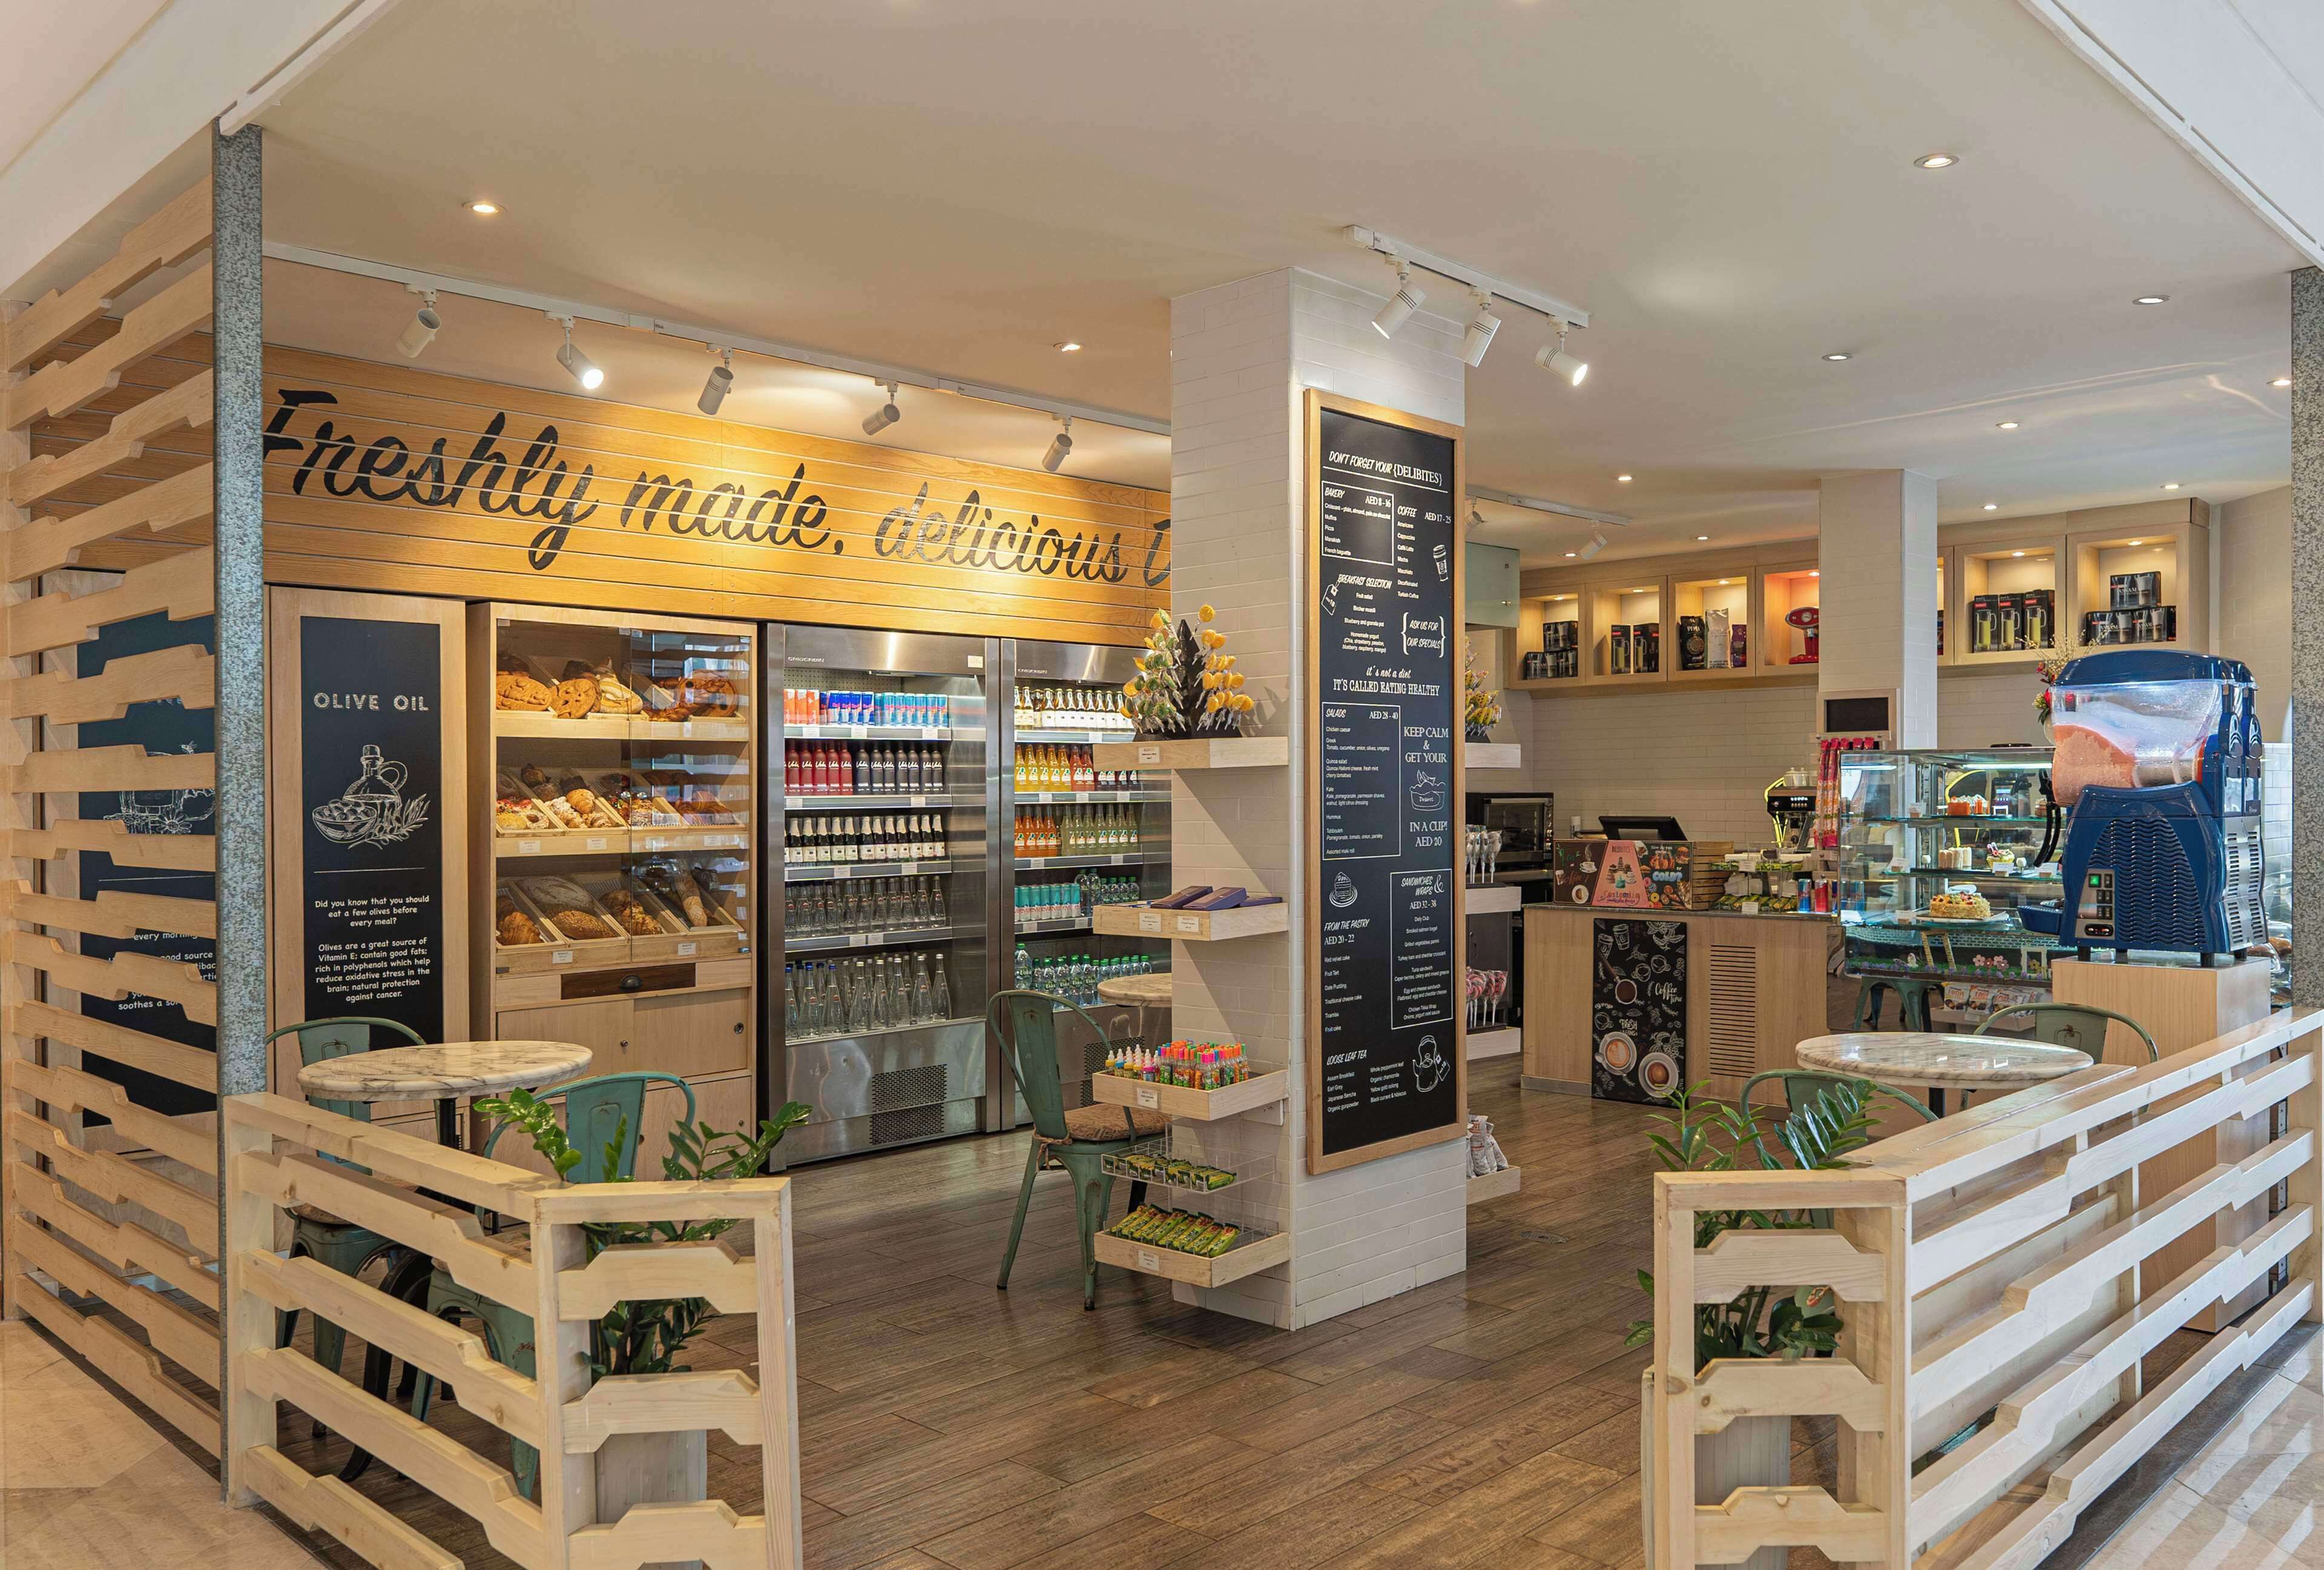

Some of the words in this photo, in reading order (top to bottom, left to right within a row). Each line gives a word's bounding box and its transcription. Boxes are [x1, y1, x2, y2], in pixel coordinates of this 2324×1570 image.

[1329, 451, 1350, 465] DON'T
[1349, 455, 1375, 470] FORGET
[1375, 460, 1392, 474] YOUR
[263, 389, 599, 571] Freshly
[621, 463, 844, 556] made,
[875, 482, 1128, 583] delicious
[1325, 487, 1345, 499] BAKERY
[1365, 496, 1378, 505] AED
[1386, 499, 1391, 508] 16
[1397, 505, 1417, 517] COFFEE
[1424, 512, 1436, 521] AED
[1338, 574, 1366, 586] BREAKFAST
[1366, 577, 1392, 590] SELECTION
[1409, 620, 1420, 629] ASK
[1420, 622, 1427, 630] US
[1427, 622, 1439, 631] FOR
[1407, 637, 1418, 646] OUR
[1418, 639, 1441, 649] SPECIALS
[1380, 668, 1392, 677] not
[1398, 669, 1411, 678] diet
[1333, 679, 1348, 691] IT'S
[1349, 680, 1378, 692] CALLED
[1380, 683, 1407, 694] EATING
[1408, 684, 1440, 696] HEALTHY
[314, 692, 379, 711] OLIVE
[393, 695, 429, 711] OIL
[1326, 709, 1346, 718] SALADS
[1404, 726, 1424, 737] KEEP
[1426, 728, 1449, 738] CALM
[1423, 740, 1430, 750] &
[1405, 752, 1421, 763] GET
[1423, 753, 1447, 763] YOUR
[1410, 822, 1420, 832] IN
[1421, 823, 1428, 832] A
[1430, 821, 1448, 831] CUP!
[1415, 837, 1433, 847] AED
[1434, 836, 1443, 846] 20
[1401, 876, 1433, 887] SANDWICHES
[1434, 875, 1444, 893] &
[1415, 886, 1433, 896] WRAPS
[1409, 901, 1421, 910] AED
[1324, 922, 1340, 931] FROM
[1340, 920, 1351, 930] THE
[1351, 919, 1370, 929] PASTRY
[369, 941, 389, 950] great
[1325, 936, 1337, 945] AED
[1338, 935, 1345, 944] 20
[390, 949, 407, 959] good
[343, 961, 387, 972] polyphenols
[415, 957, 430, 966] help
[346, 972, 380, 981] oxidative
[352, 982, 379, 990] natural
[382, 979, 420, 990] protection
[1655, 982, 1677, 1000] Coffee
[346, 993, 373, 1003] against
[118, 1000, 153, 1010] soothes
[1327, 1055, 1344, 1066] LOOSE
[1345, 1051, 1356, 1063] LEAF
[1357, 1049, 1367, 1060] TEA
